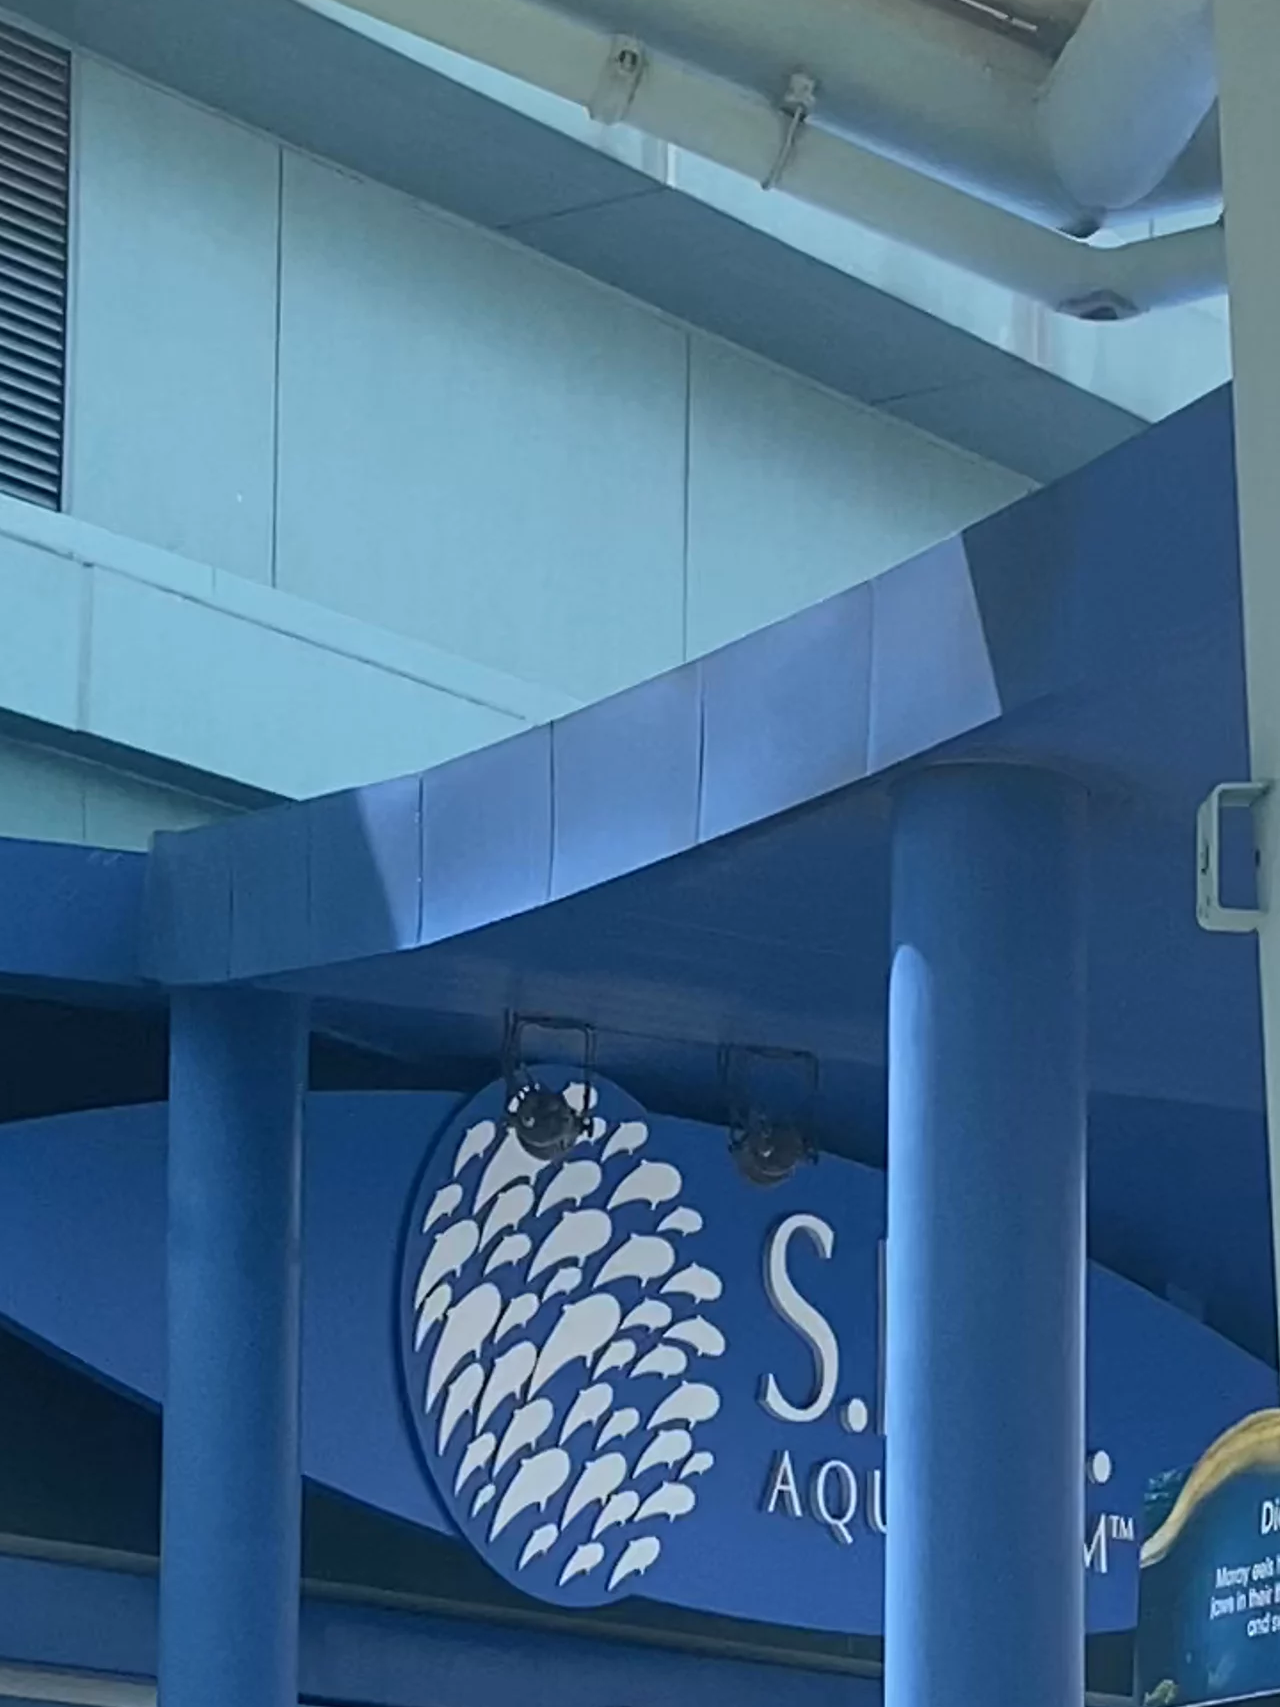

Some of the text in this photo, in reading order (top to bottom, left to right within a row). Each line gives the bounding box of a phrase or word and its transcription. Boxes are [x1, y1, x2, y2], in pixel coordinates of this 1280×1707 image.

[1252, 1558, 1273, 1579] eels
[1236, 1592, 1247, 1612] in
[1249, 1586, 1271, 1608] their
[1247, 1613, 1269, 1637] and
